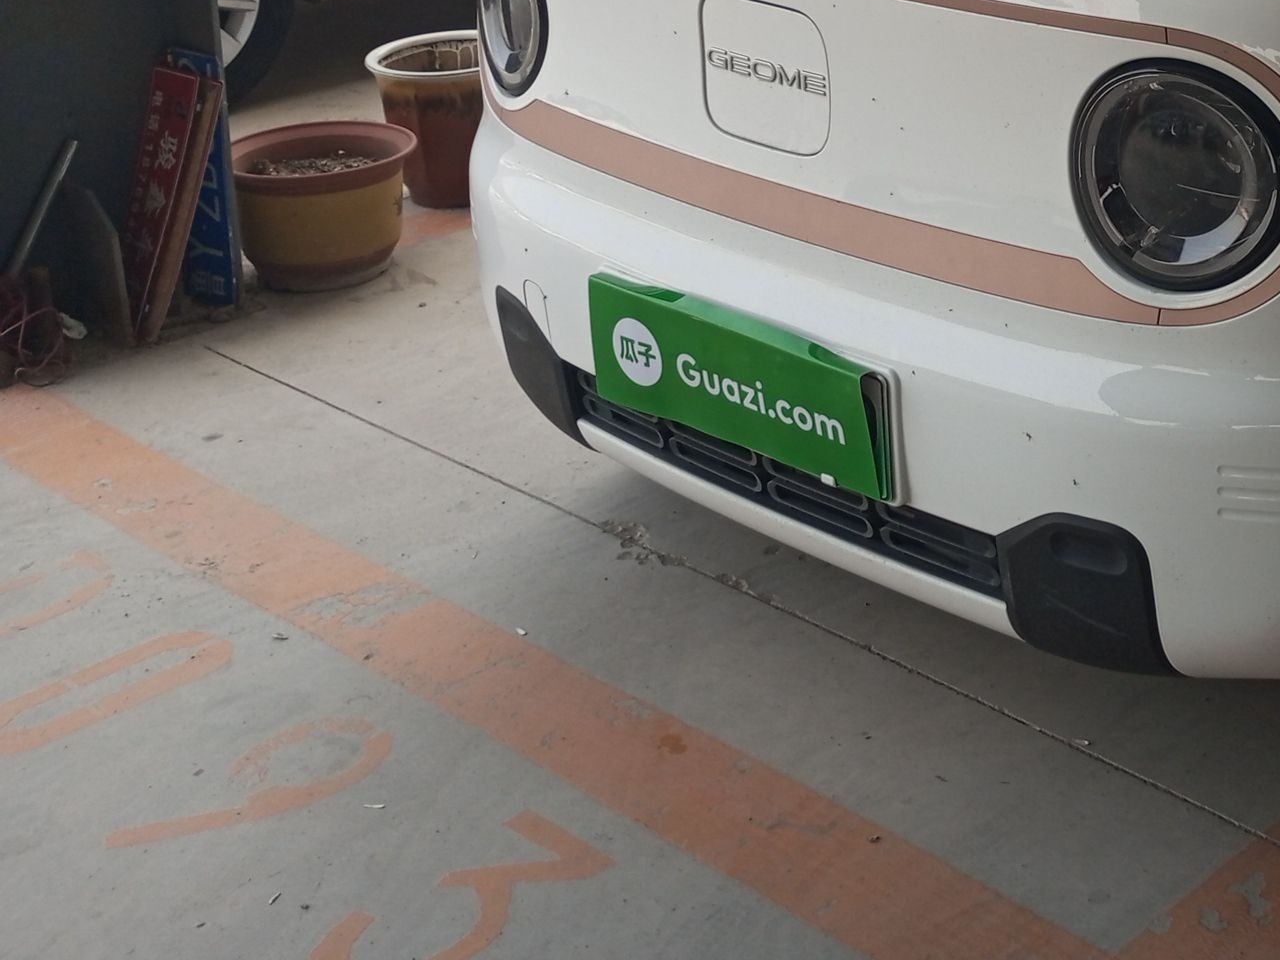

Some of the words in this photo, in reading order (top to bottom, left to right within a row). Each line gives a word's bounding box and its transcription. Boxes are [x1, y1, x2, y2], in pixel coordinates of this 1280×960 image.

[707, 46, 827, 96] GEOME
[619, 334, 656, 368] 瓜子
[676, 353, 846, 445] Guazi.com
